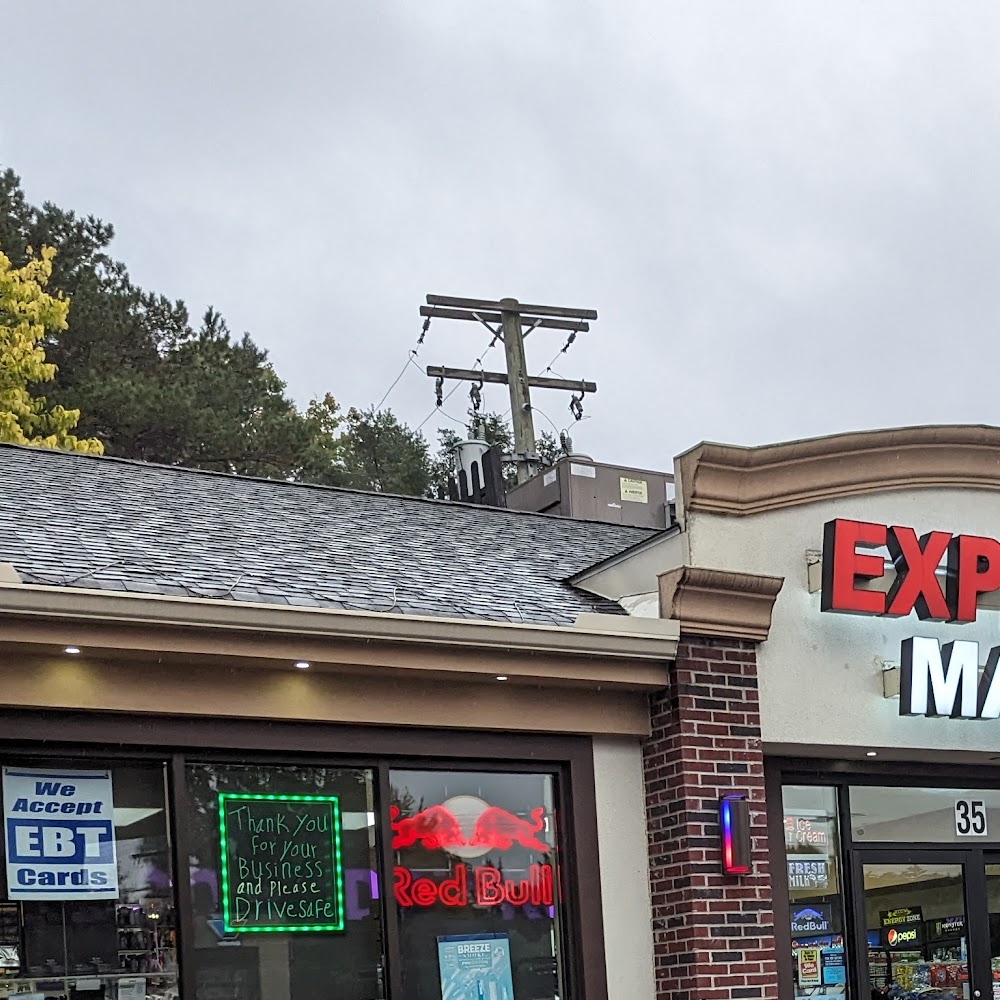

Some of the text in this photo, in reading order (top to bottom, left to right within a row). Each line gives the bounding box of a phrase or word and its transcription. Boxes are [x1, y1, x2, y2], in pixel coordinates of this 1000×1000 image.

[35, 781, 76, 797] We
[11, 798, 103, 815] Accept
[228, 806, 290, 835] Thank
[796, 819, 811, 831] Ice
[956, 800, 985, 834] 35
[14, 825, 107, 858] EBT
[796, 830, 826, 843] Cream
[17, 868, 108, 886] Cards
[238, 857, 323, 880] Business
[788, 862, 825, 875] FRESH
[236, 878, 263, 895] and
[393, 864, 553, 907] Red Bull
[788, 874, 811, 888] MILK
[897, 929, 917, 943] pepsi
[457, 943, 491, 954] BREEZE
